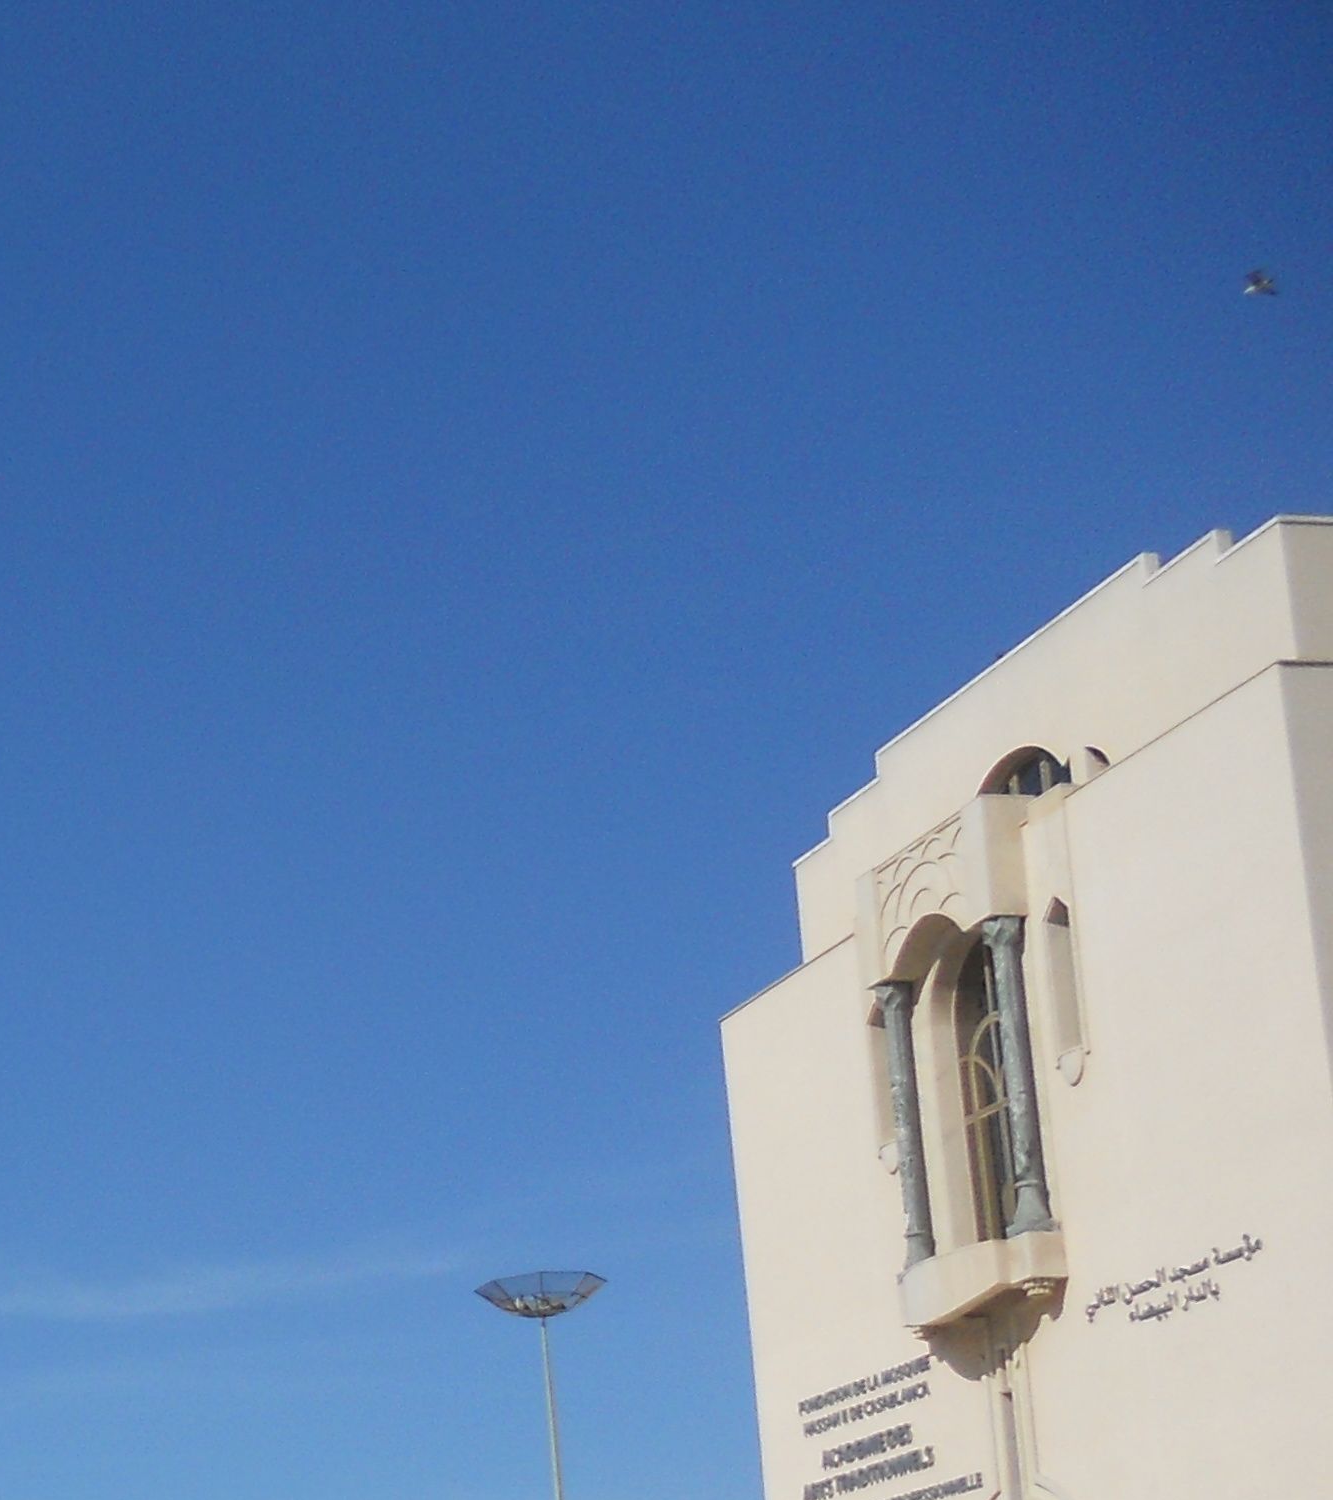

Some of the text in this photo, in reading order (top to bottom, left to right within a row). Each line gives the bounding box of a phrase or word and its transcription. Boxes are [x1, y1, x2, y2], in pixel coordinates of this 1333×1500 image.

[798, 1384, 852, 1416] FONDATION
[853, 1378, 867, 1396] DE
[867, 1374, 881, 1391] LA
[803, 1412, 841, 1438] HASSAN
[849, 1404, 864, 1421] DE
[864, 1381, 931, 1416] CASABLANCA
[836, 1446, 935, 1495] TRADITIONNELS
